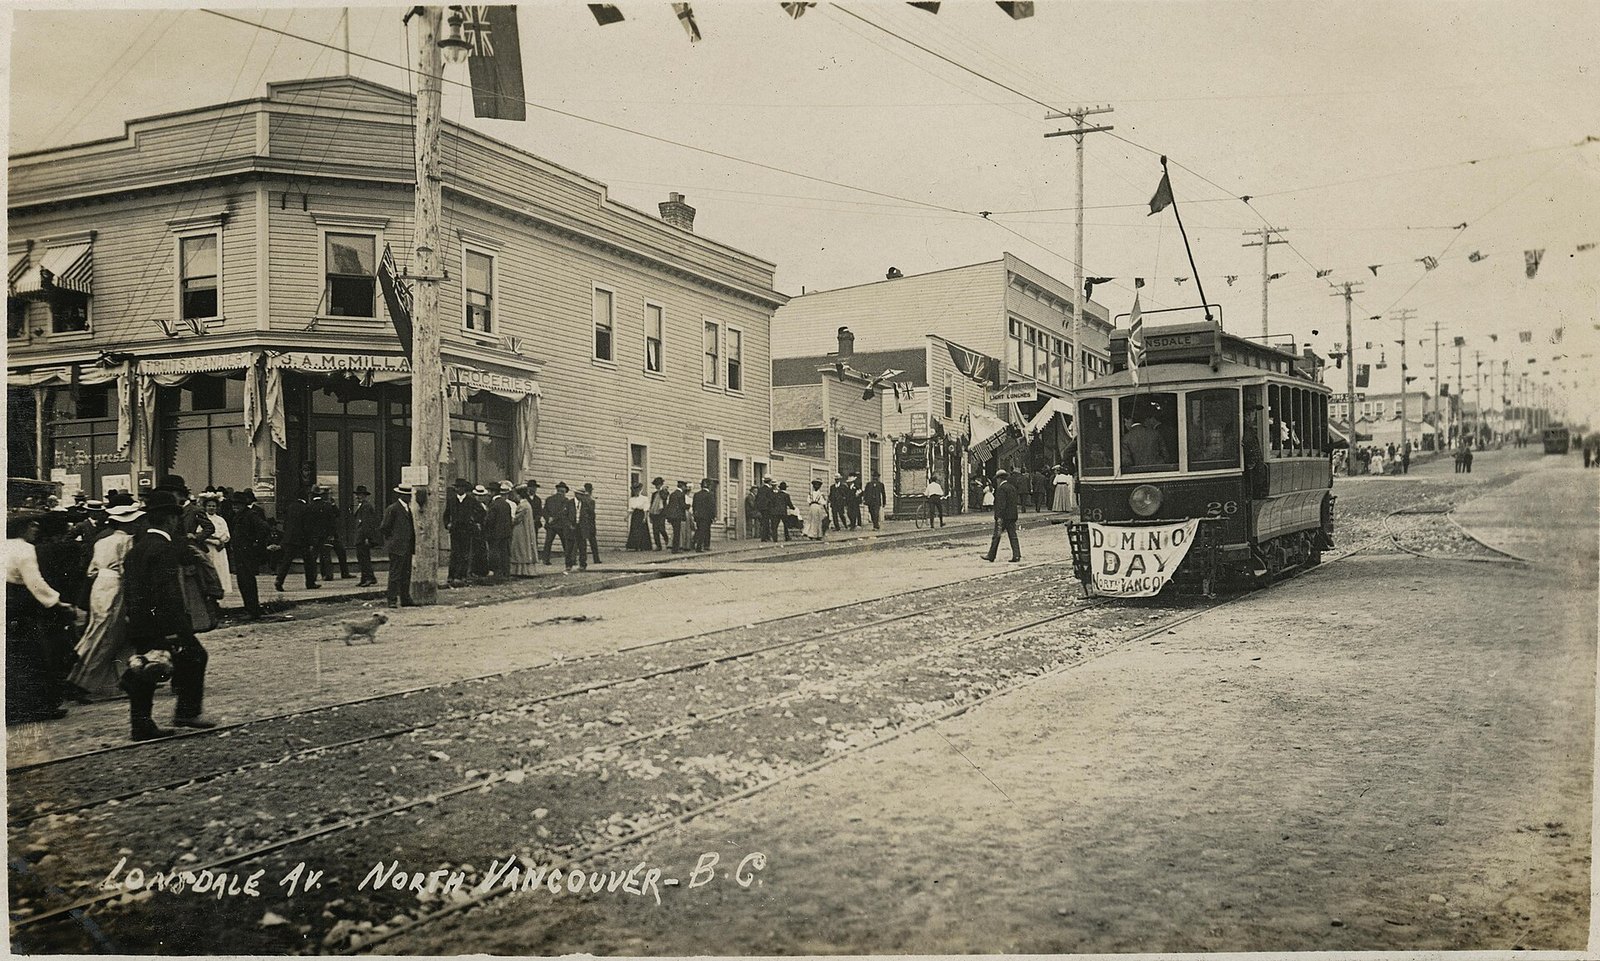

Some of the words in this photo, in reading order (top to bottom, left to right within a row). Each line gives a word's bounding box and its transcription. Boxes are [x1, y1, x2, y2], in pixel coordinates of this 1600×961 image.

[1145, 335, 1193, 349] NSDALE
[194, 354, 243, 371] CANDIES
[281, 354, 297, 366] J.
[301, 354, 319, 366] A.
[321, 355, 411, 369] McMILLA
[461, 370, 530, 392] ROCERIES
[1206, 500, 1239, 515] 26
[1102, 549, 1172, 578] DAY
[1121, 576, 1165, 592] VANCO
